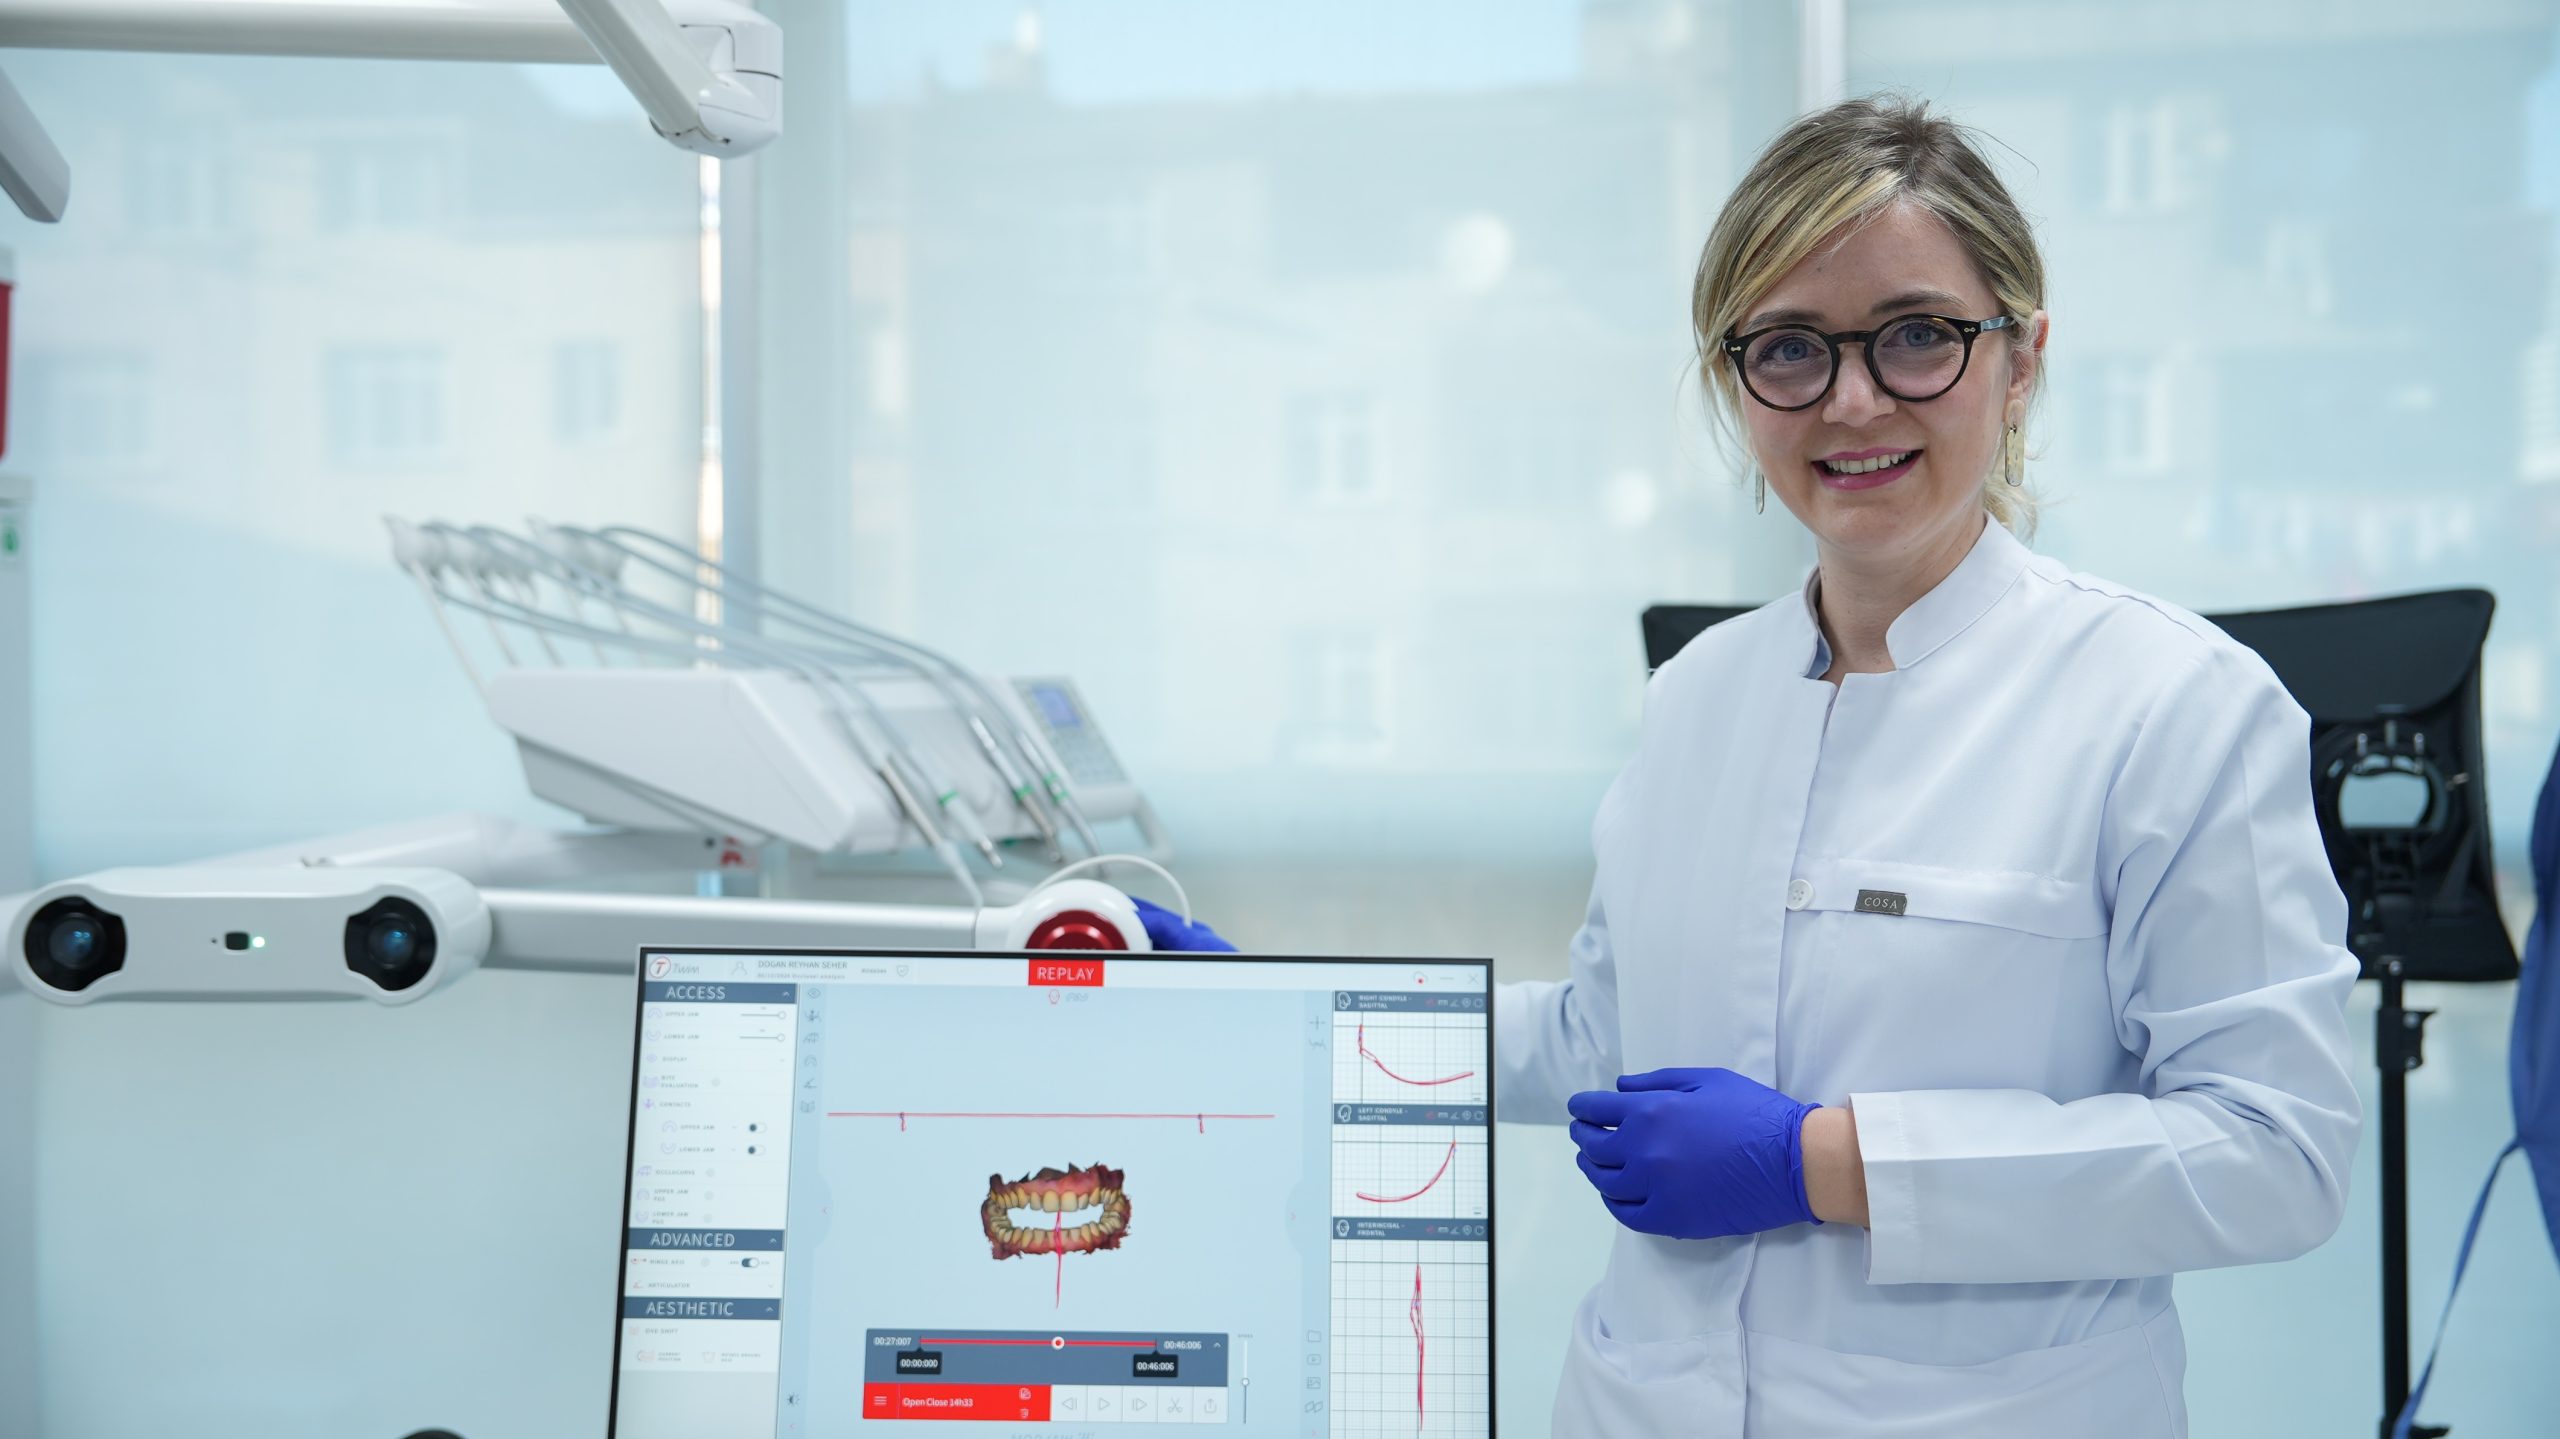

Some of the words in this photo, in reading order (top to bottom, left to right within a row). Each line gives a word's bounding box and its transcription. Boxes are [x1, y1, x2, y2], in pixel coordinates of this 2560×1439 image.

[1864, 897, 1897, 909] COSA
[821, 961, 848, 969] SEHER
[1036, 966, 1095, 981] REPLAY
[665, 985, 726, 1001] ACCESS
[650, 1232, 735, 1247] ADVANCED
[646, 1301, 735, 1316] AESTHETIC
[873, 1336, 912, 1346] 00:27:007
[1163, 1340, 1202, 1350] 00:46:006
[900, 1359, 939, 1368] 00:00:000
[1136, 1361, 1175, 1372] 00:46:006
[902, 1397, 926, 1408] Open
[926, 1397, 949, 1407] Close
[949, 1398, 974, 1407] 14h33
